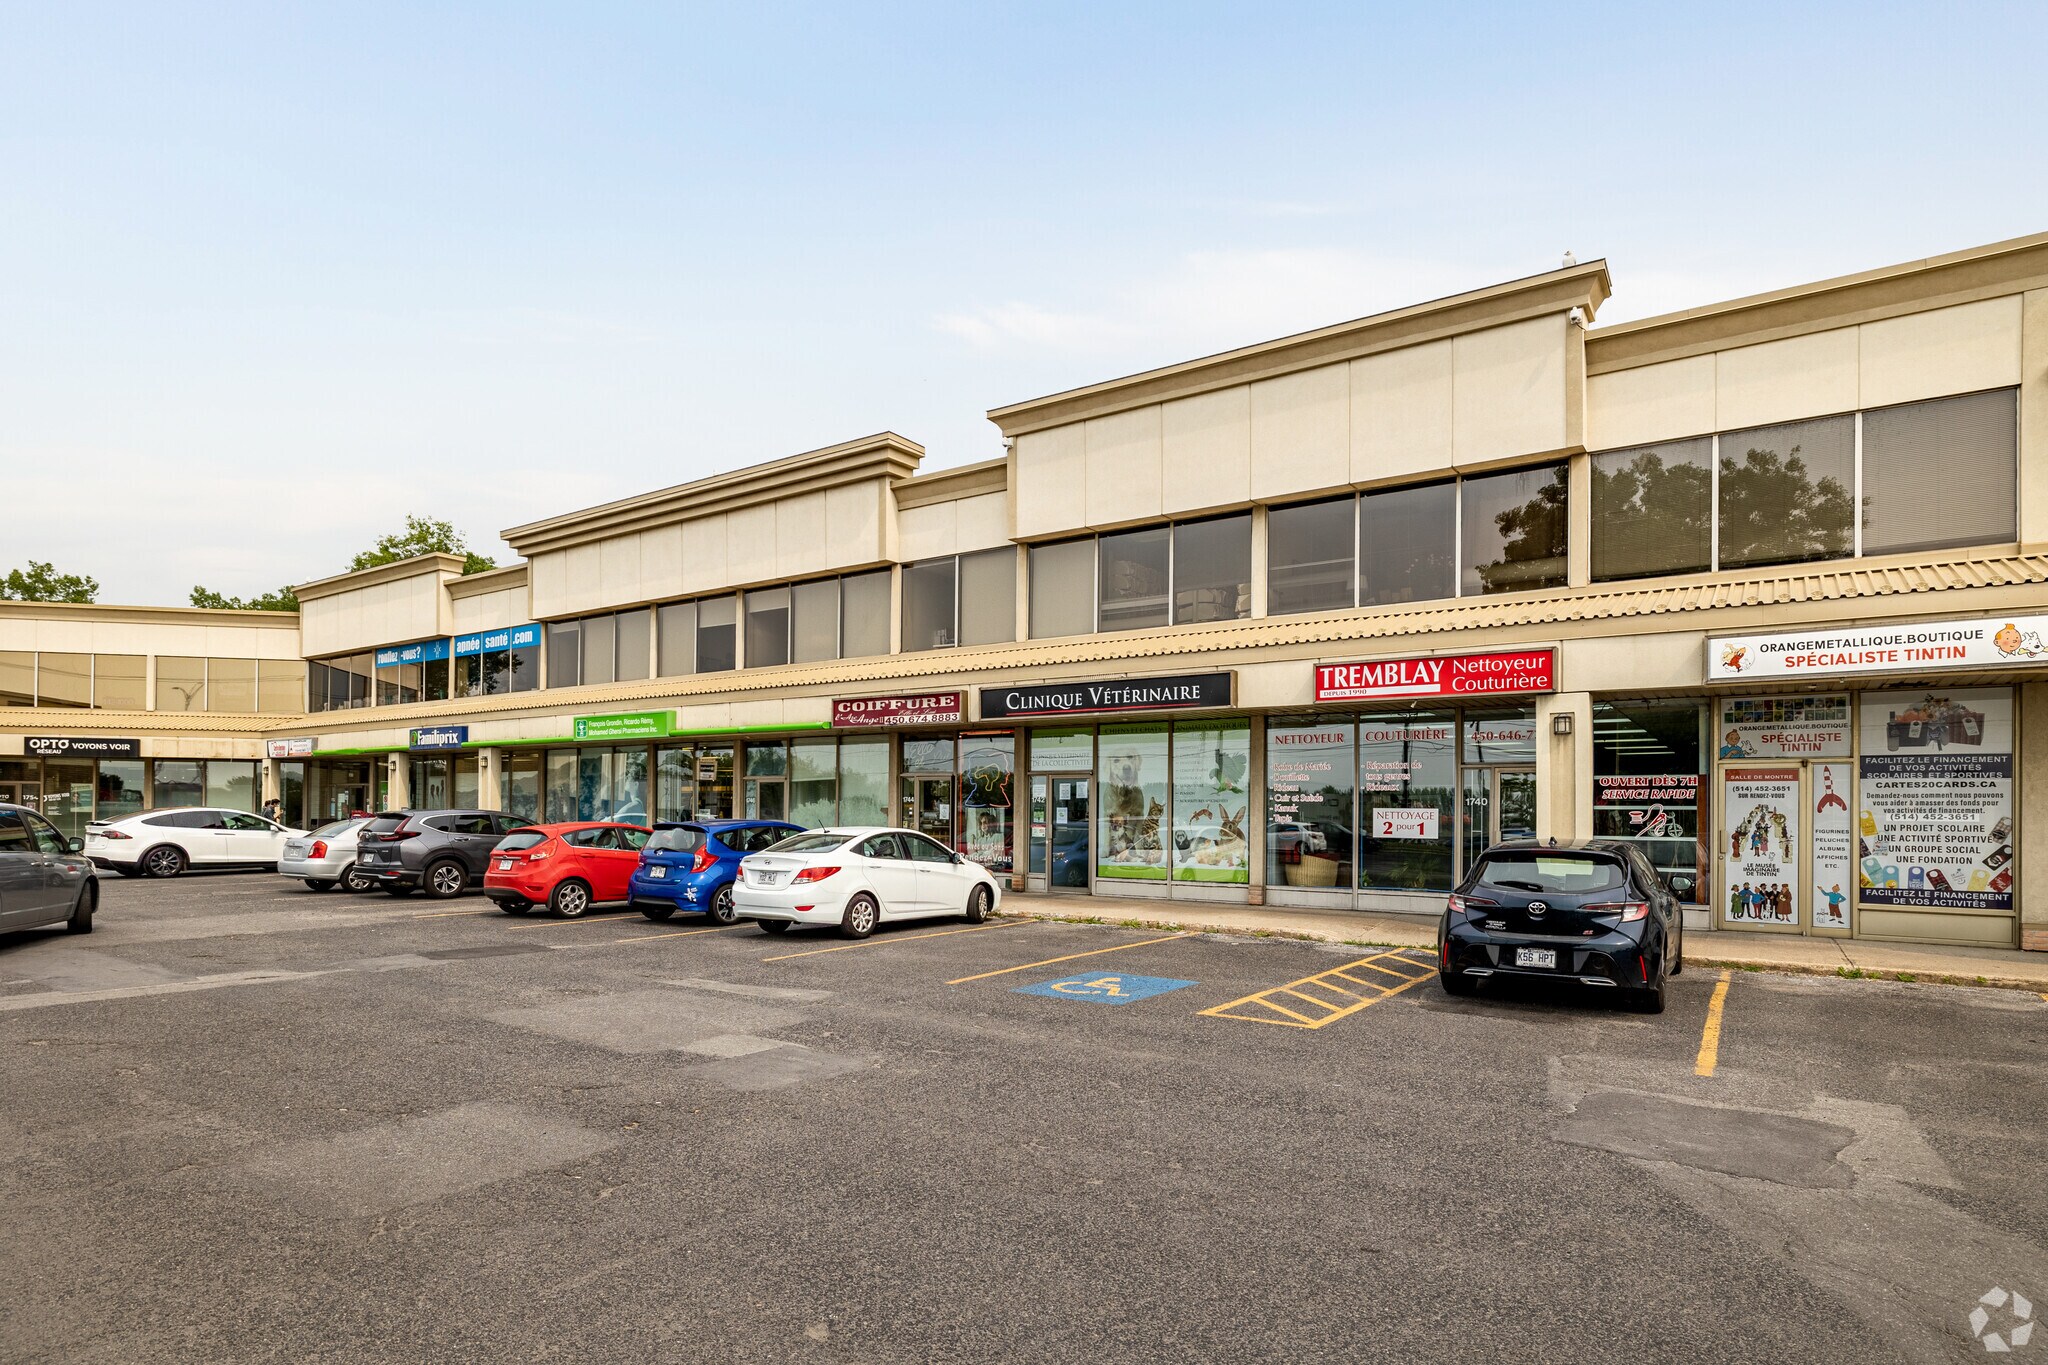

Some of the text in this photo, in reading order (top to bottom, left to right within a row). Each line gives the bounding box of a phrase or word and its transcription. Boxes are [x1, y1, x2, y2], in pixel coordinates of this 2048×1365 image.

[456, 630, 533, 653] apnée santé .com
[1759, 629, 1984, 653] ORANGEMETALLIQUE.BOUTIQUE
[1785, 646, 1966, 669] SPÉCIALISTE TINTIN
[1453, 656, 1546, 675] Nettoyeur
[1319, 660, 1445, 689] TREMBLAY
[1452, 672, 1548, 692] Couturière
[1005, 685, 1201, 710] CLINIQUE VÉTÉRINAIRE
[838, 696, 955, 713] COIFFURE
[886, 714, 958, 725] 450.674.8883
[1738, 723, 1849, 731] ORANGEMETALLIQUE.BOUTIQUE
[417, 729, 459, 747] Familiprix
[1275, 733, 1344, 745] NETTOYEUR
[1365, 726, 1448, 741] COUTURIÈRE
[1761, 732, 1842, 743] SPÉCIALISTE
[72, 742, 108, 750] VOYONS
[109, 743, 131, 751] VOIR
[1780, 742, 1822, 752] TINTIN
[1933, 755, 2008, 763] FINANCEMENT
[1928, 763, 1982, 771] ACTIVITÉS
[1599, 774, 1698, 787] OUVERT DÈS 7H
[1601, 788, 1696, 800] SERVICE RAPIDE
[1465, 797, 1488, 806] 1740
[1376, 811, 1435, 820] NETTOYAGE
[1890, 813, 1919, 821] (514)
[1383, 821, 1425, 836] 2 pour 1
[1900, 824, 1934, 832] PROJET
[1937, 824, 1985, 832] SCOLAIRE
[1877, 833, 1993, 843] UNE ACTIVITÉ SPORTIVE
[1904, 845, 1943, 853] GROUPE
[1945, 846, 1981, 854] SOCIAL
[1918, 856, 1973, 864] FONDATION
[1866, 889, 1915, 897] FACILITEZ
[1934, 891, 2009, 901] FINANCEMENT
[1932, 899, 1986, 908] ACTIVITÉS
[1517, 952, 1555, 963] K56 HPT
